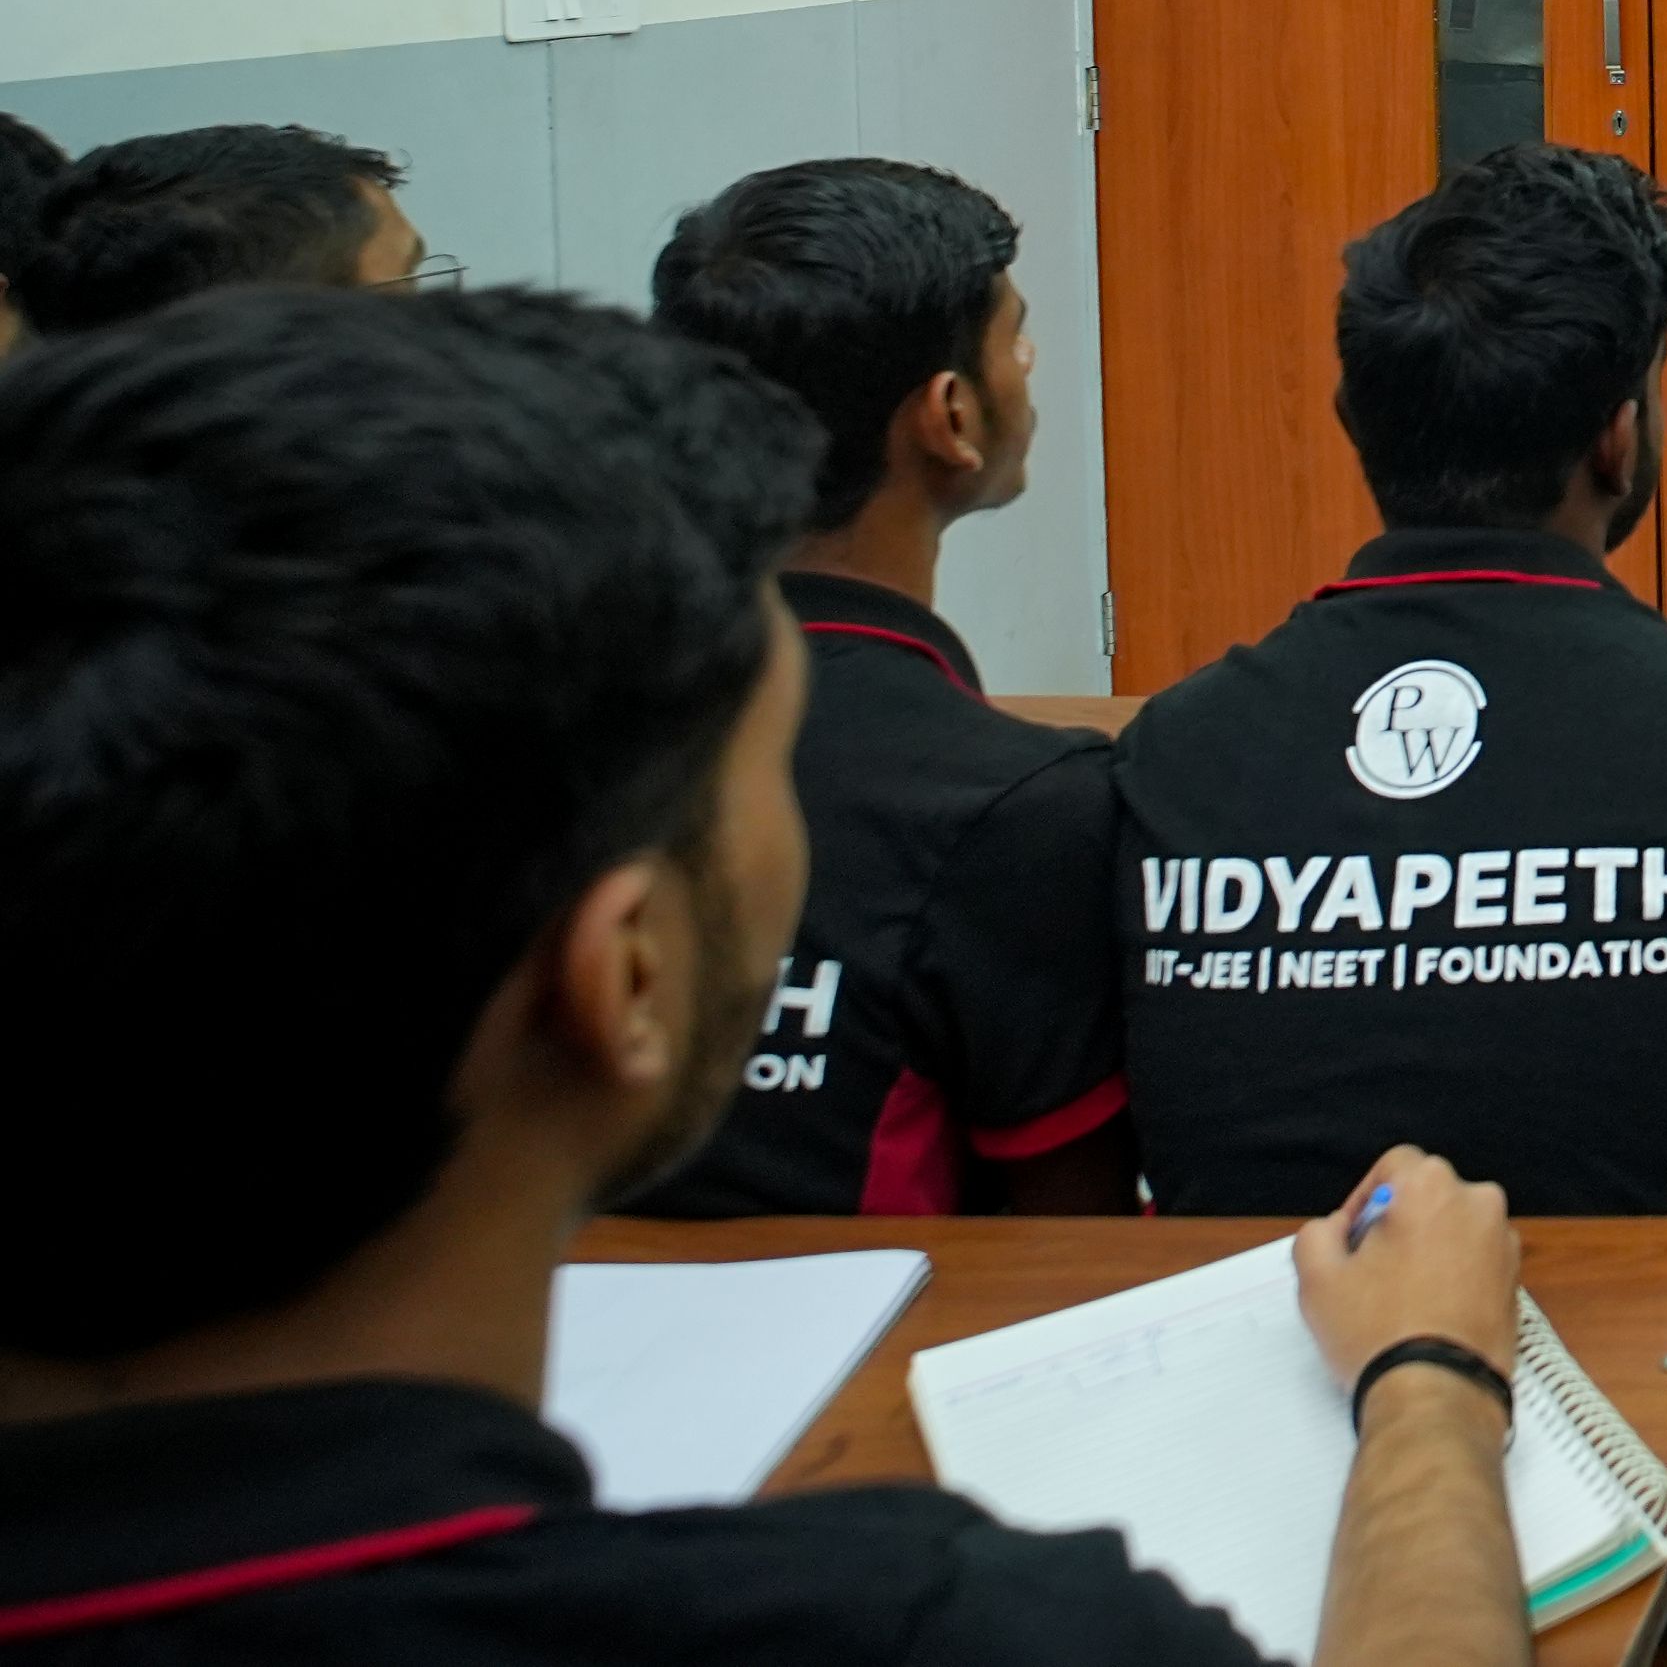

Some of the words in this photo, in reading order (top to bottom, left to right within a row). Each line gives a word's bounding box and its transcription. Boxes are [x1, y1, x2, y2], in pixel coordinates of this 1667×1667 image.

[1382, 684, 1463, 781] PW
[1144, 948, 1254, 990] IIT-JEE
[1276, 948, 1386, 990] NEET
